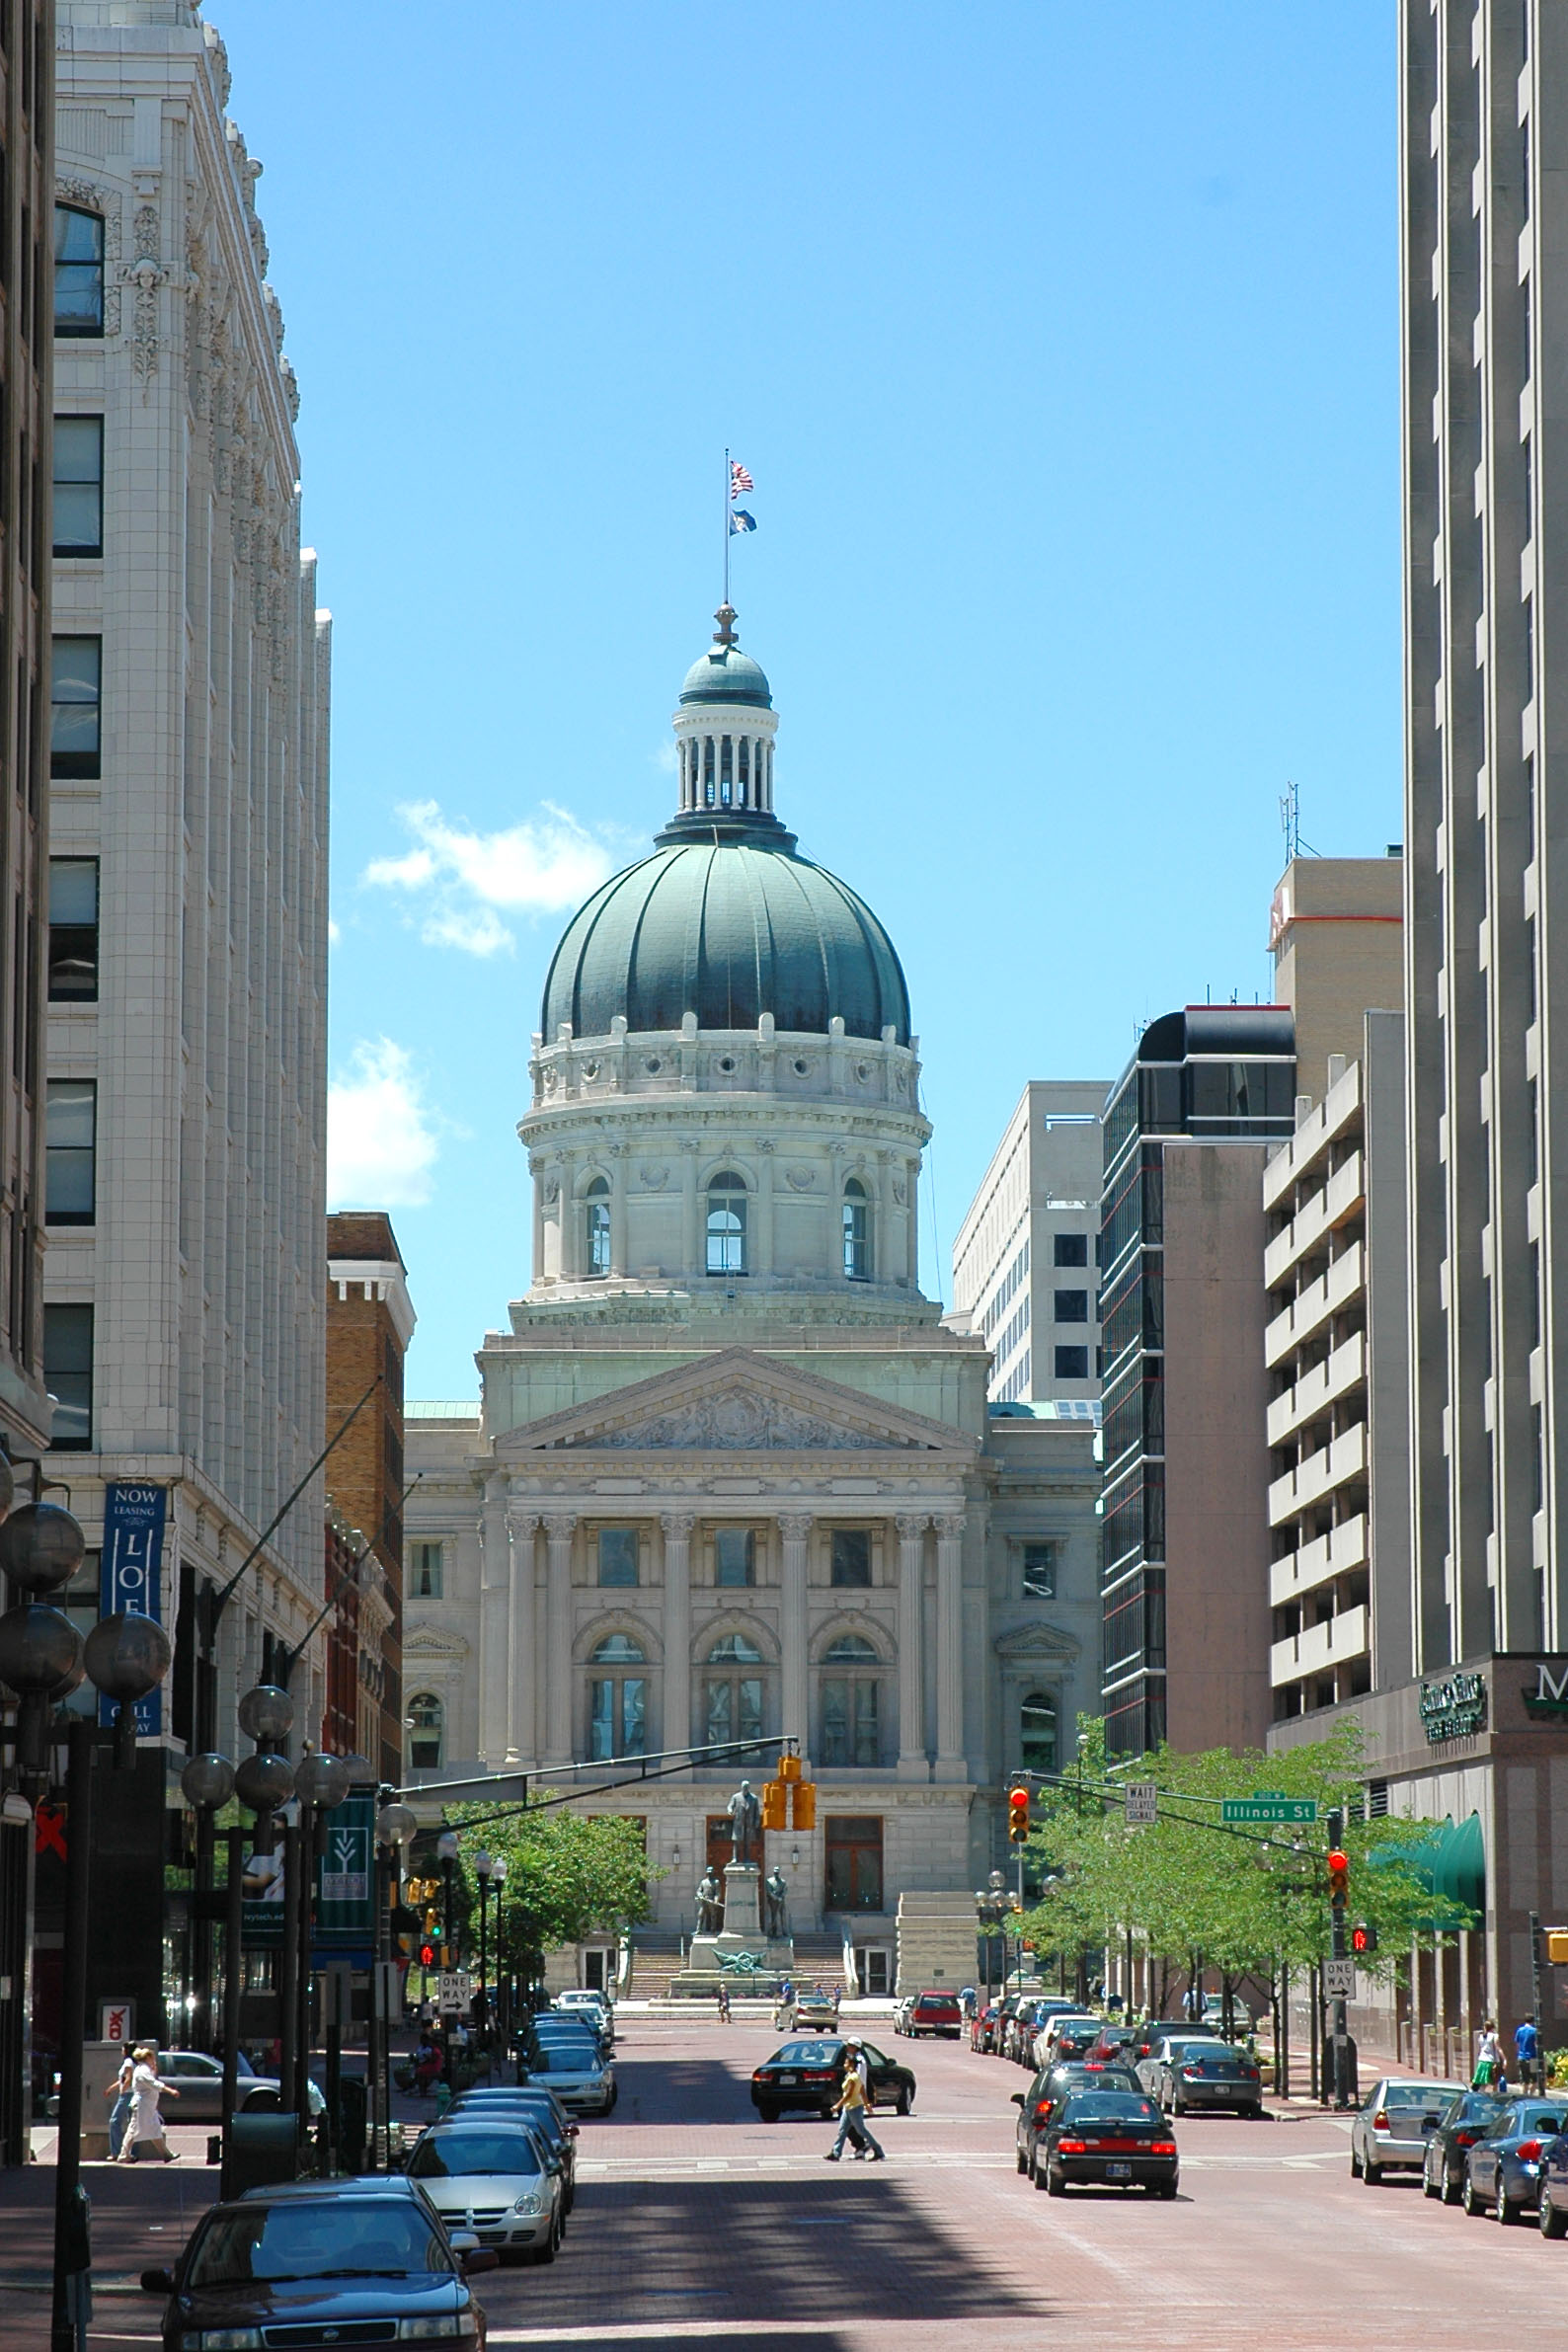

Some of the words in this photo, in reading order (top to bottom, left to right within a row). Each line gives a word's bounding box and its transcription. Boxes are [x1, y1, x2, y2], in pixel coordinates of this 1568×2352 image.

[115, 1489, 158, 1503] NOW
[114, 1506, 155, 1517] LEASING
[111, 1705, 151, 1718] CLL
[1130, 1787, 1154, 1798] WAIT
[1127, 1800, 1154, 1809] DELAYED
[1129, 1811, 1153, 1820] SIGNAL
[1227, 1805, 1286, 1818] Illinois
[1294, 1805, 1310, 1818] St
[1327, 1964, 1351, 1974] ONE
[442, 1977, 466, 1987] ONE
[1327, 1977, 1352, 1986] WAY
[442, 1990, 467, 1999] WAY
